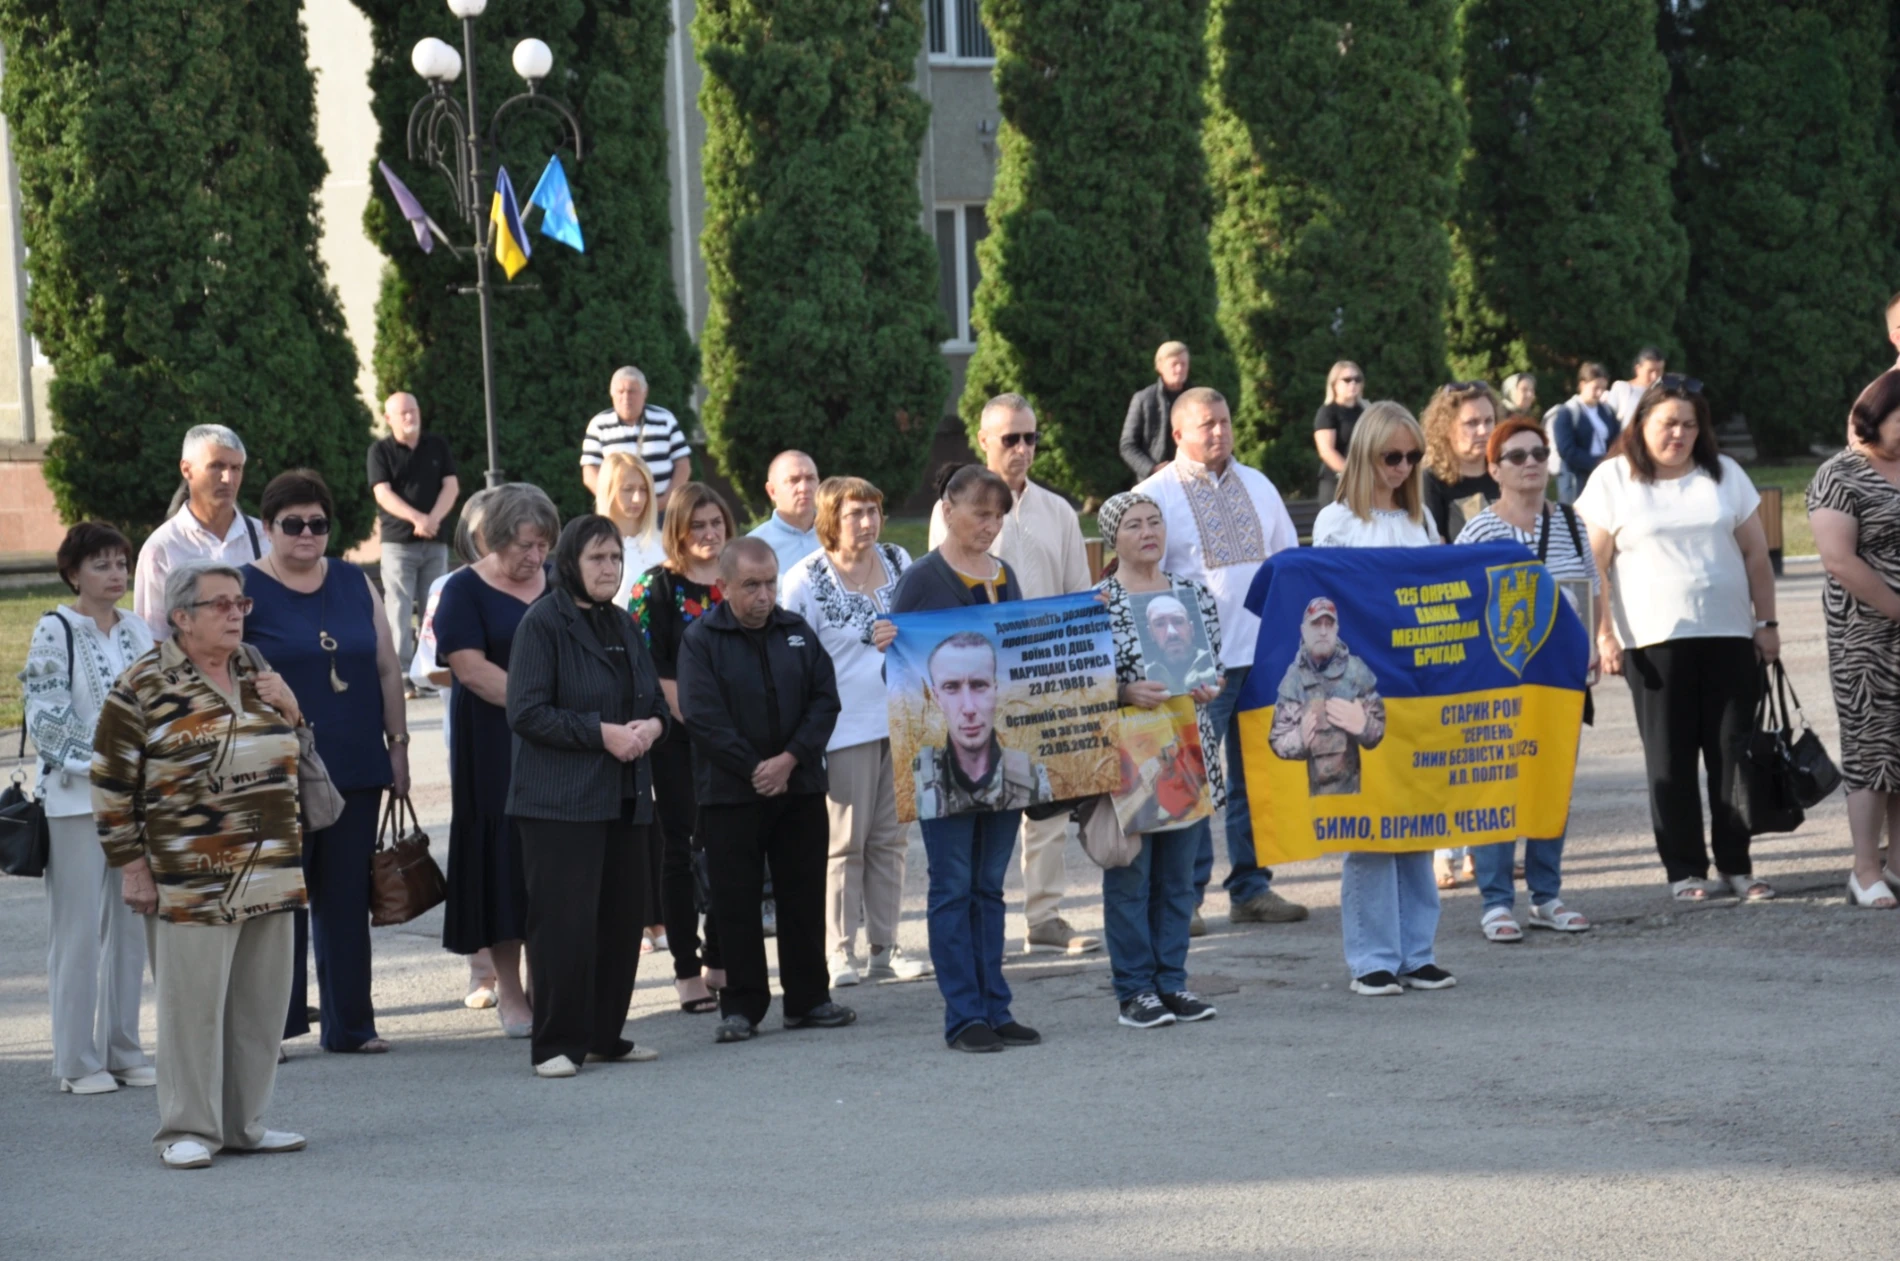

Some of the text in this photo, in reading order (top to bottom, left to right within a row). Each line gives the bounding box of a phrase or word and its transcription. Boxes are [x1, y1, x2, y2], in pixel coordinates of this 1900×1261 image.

[1394, 580, 1472, 606] 125 ОКРЕМА
[1022, 639, 1095, 661] воїна 80 ДШБ
[1414, 642, 1466, 667] БРИГАДА
[1010, 654, 1112, 680] МАРУЩАКА БОРИСА
[1441, 701, 1490, 725] СТАРИК
[1041, 728, 1057, 739] на
[1412, 750, 1447, 768] ЗНИК
[1449, 744, 1504, 766] БЕЗВІСТИ
[1313, 815, 1375, 841] БИМО,
[1380, 812, 1451, 839] ВІРИМО,
